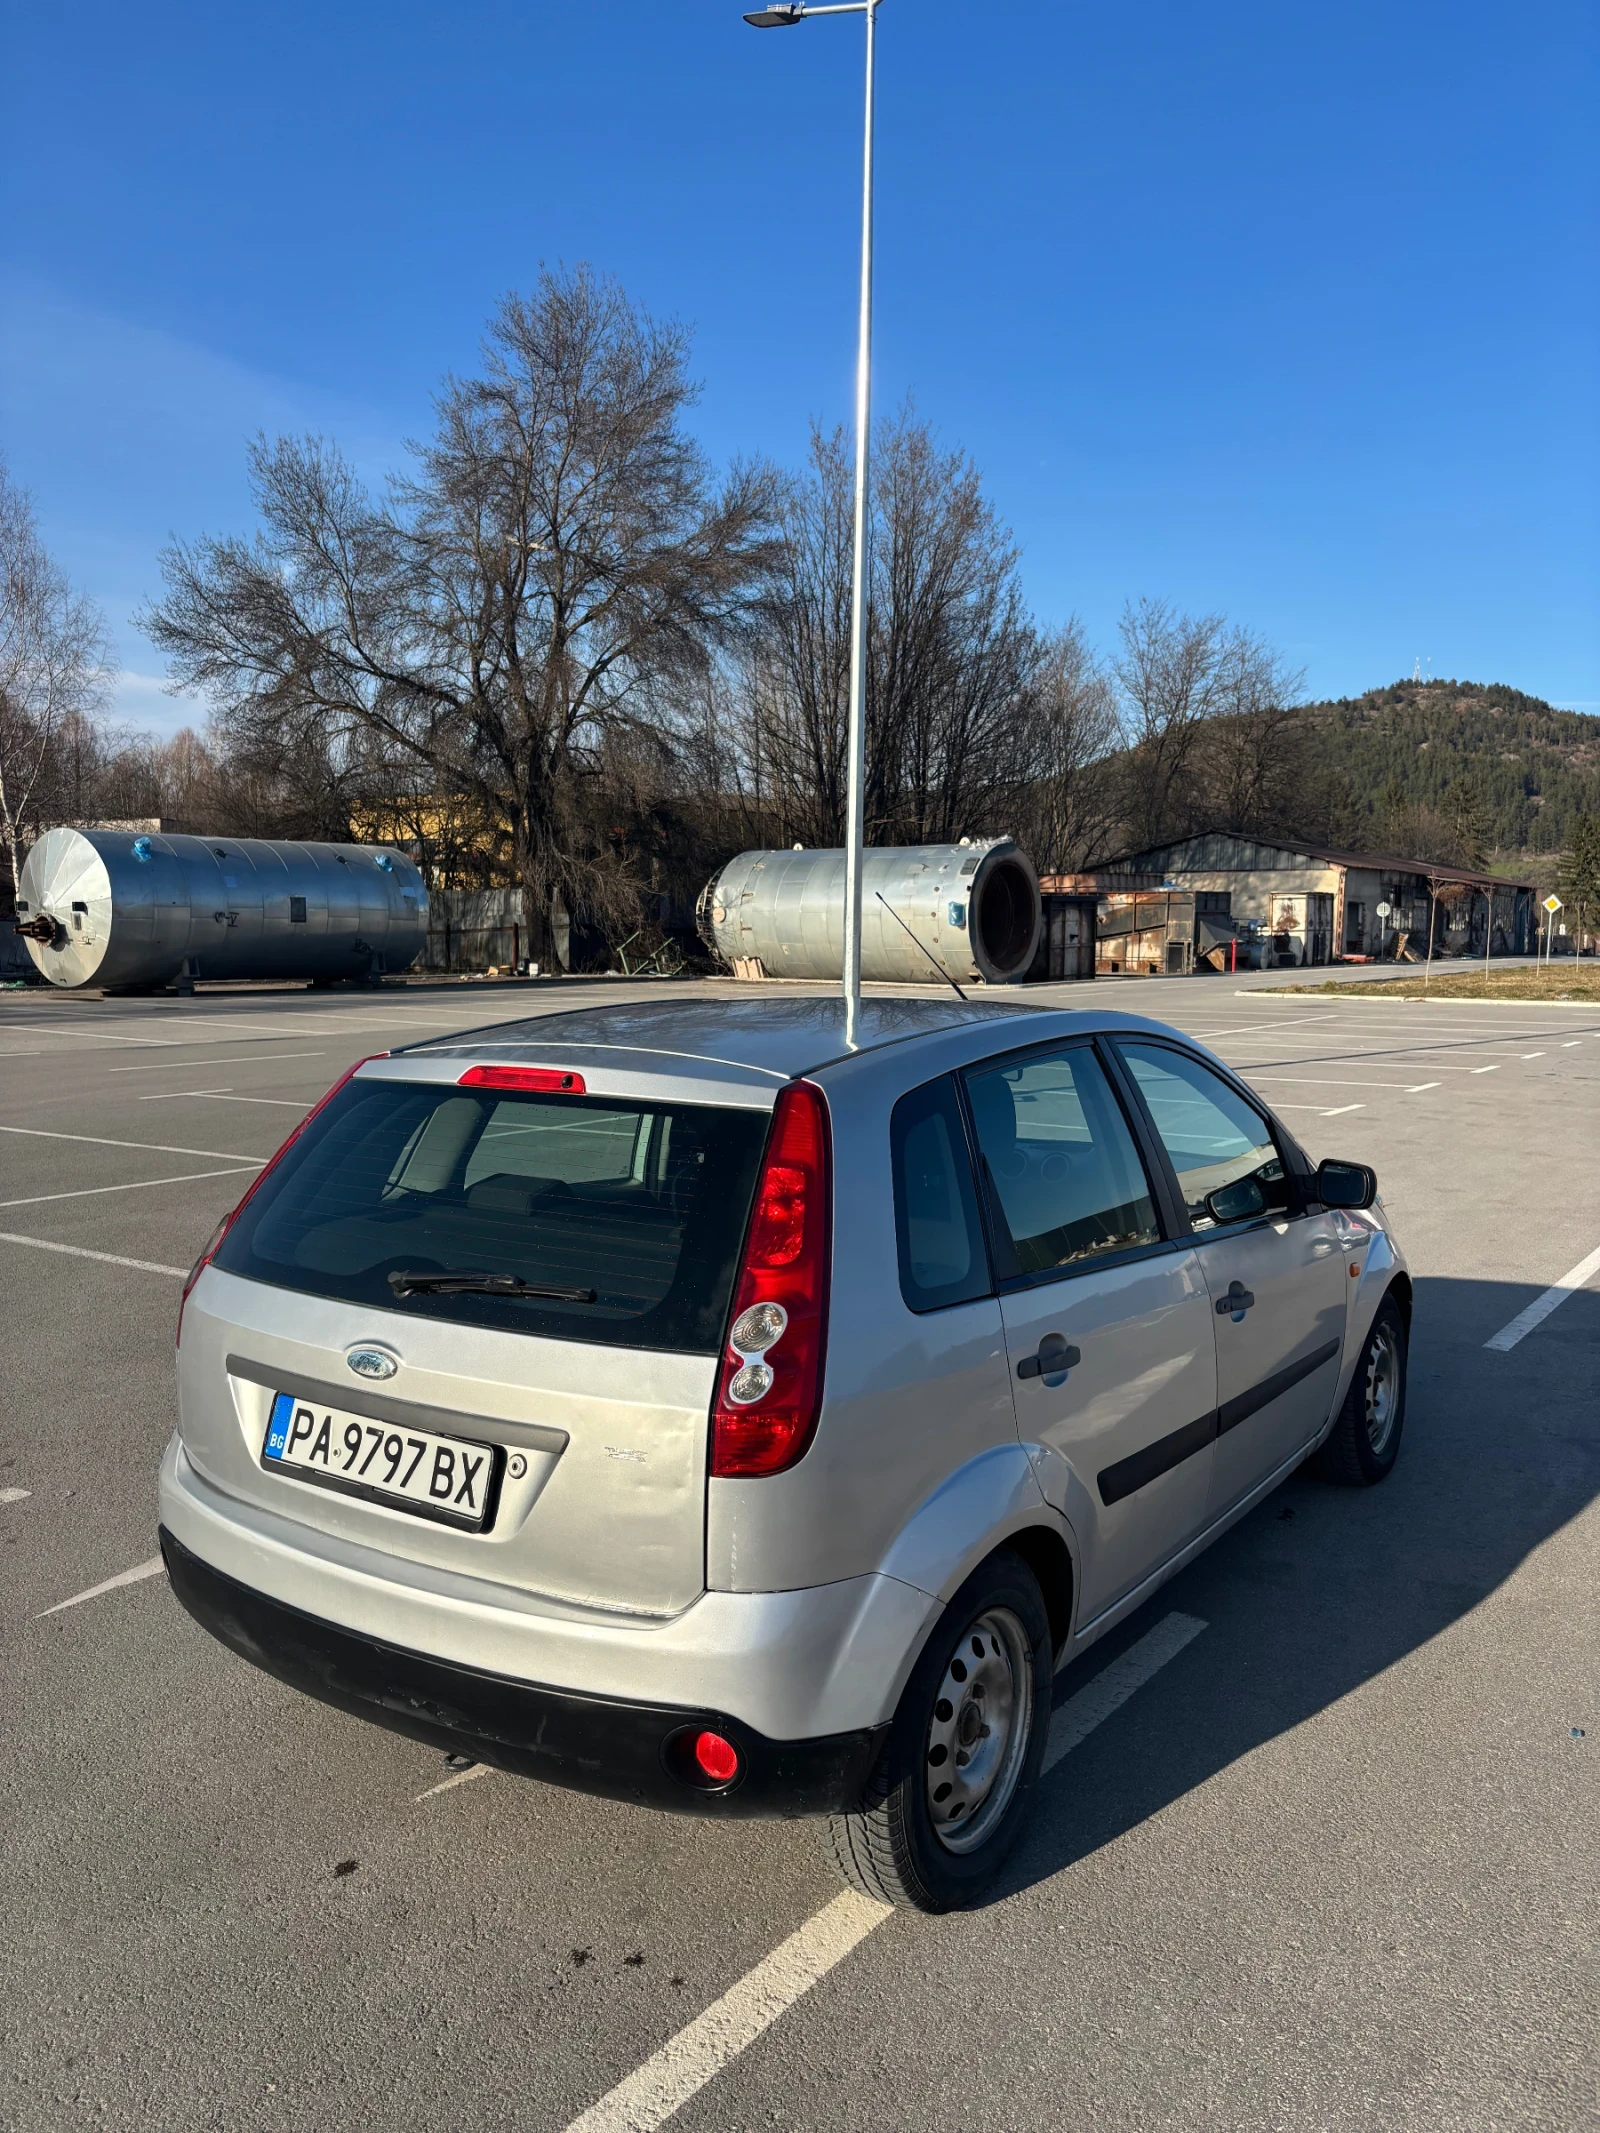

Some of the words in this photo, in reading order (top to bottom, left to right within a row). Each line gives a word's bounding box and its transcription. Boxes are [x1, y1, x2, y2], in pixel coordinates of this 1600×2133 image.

[269, 1433, 284, 1449] BG
[287, 1408, 332, 1465] PA
[343, 1423, 427, 1488] 9797
[430, 1446, 484, 1508] BX
